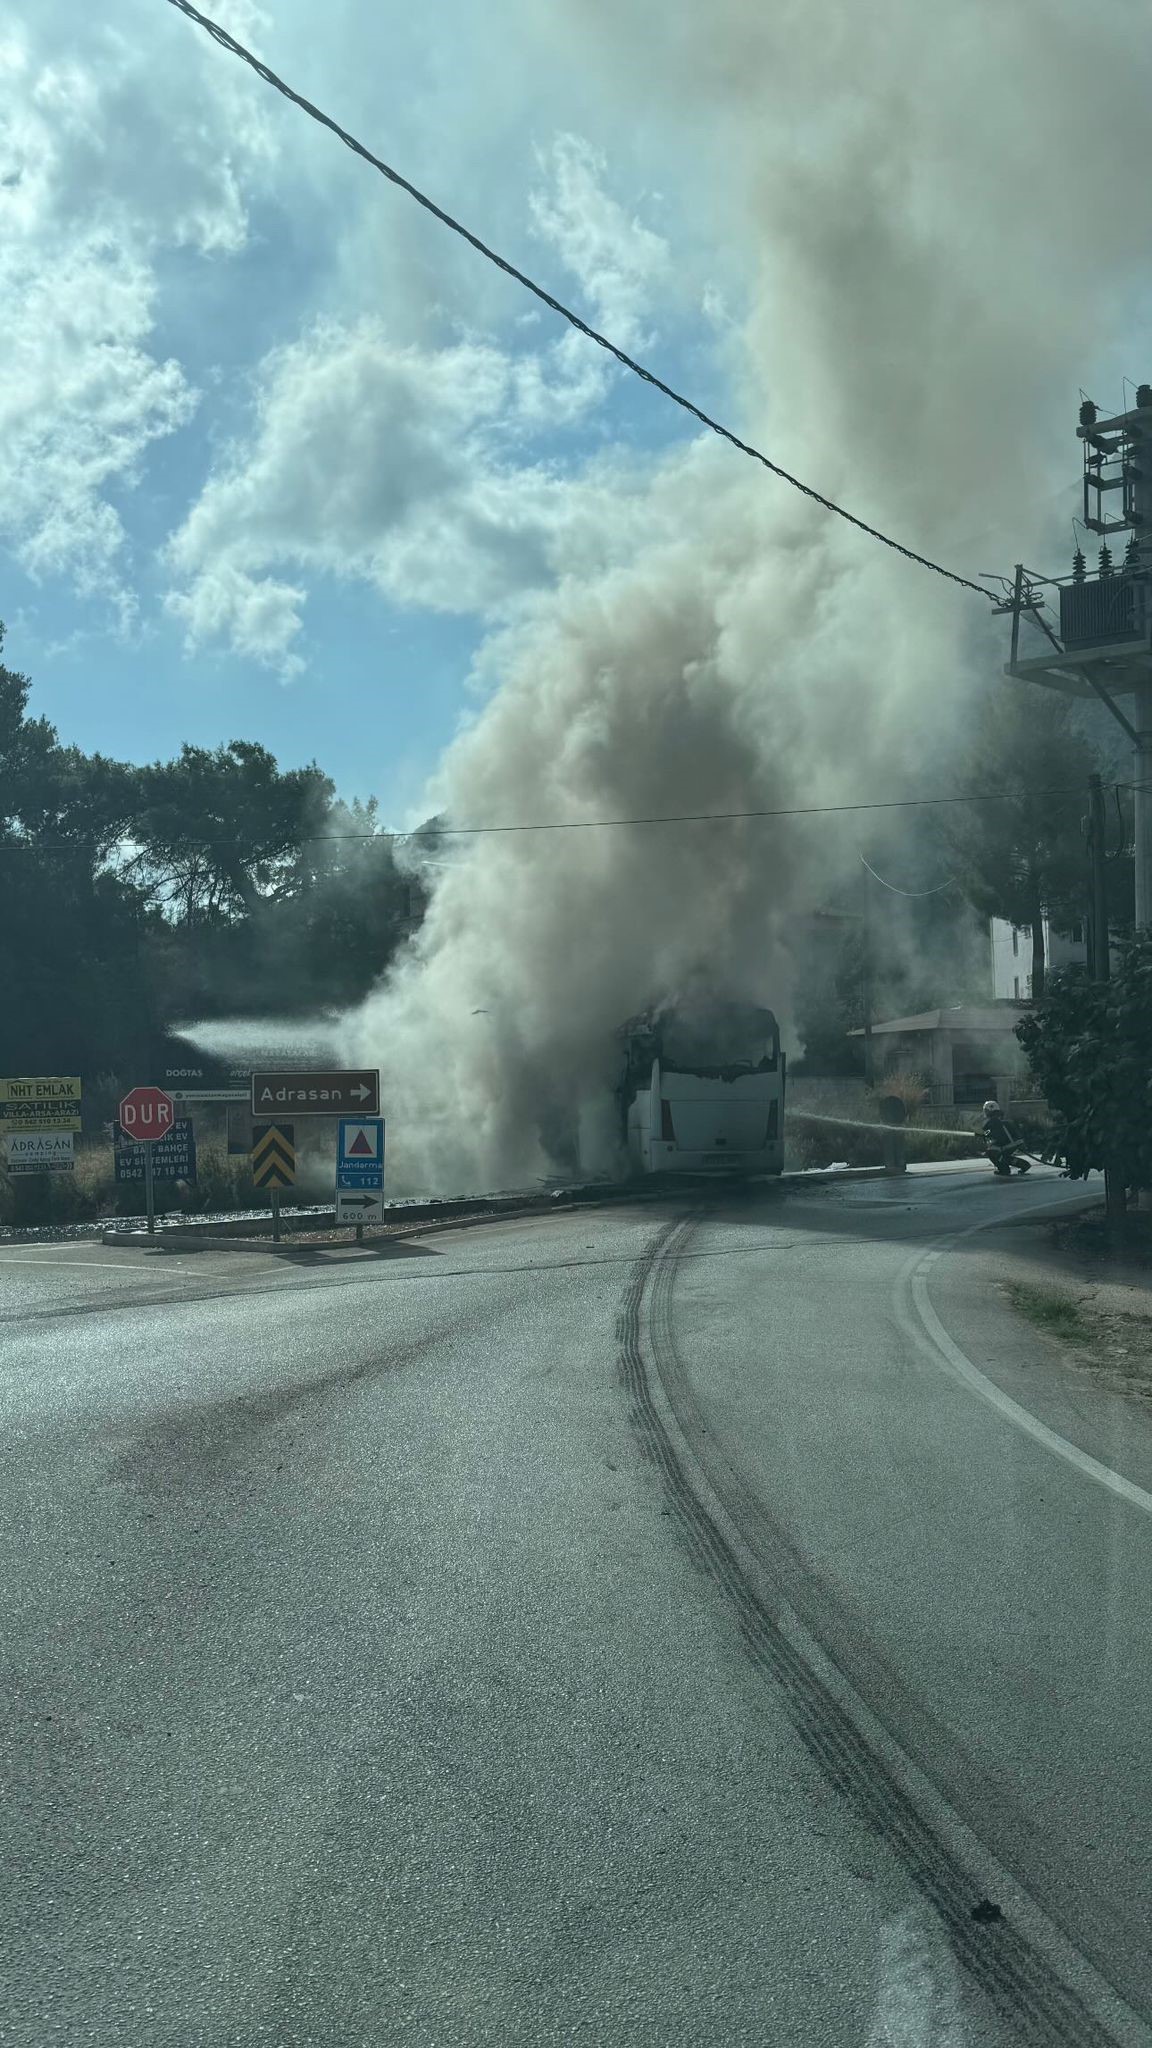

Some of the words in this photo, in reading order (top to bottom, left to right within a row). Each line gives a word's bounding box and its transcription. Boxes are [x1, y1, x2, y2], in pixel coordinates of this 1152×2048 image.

[10, 1084, 33, 1097] NHT
[36, 1083, 75, 1096] EMLAK
[260, 1087, 342, 1101] Adrasan
[6, 1101, 77, 1111] SATILIK
[124, 1103, 170, 1125] DUR
[11, 1136, 71, 1152] ADRASAN
[120, 1158, 132, 1167] EV
[134, 1153, 189, 1165] SİTEMLERİ
[339, 1161, 383, 1169] Jandarma
[361, 1177, 380, 1186] 112
[342, 1212, 364, 1220] 600
